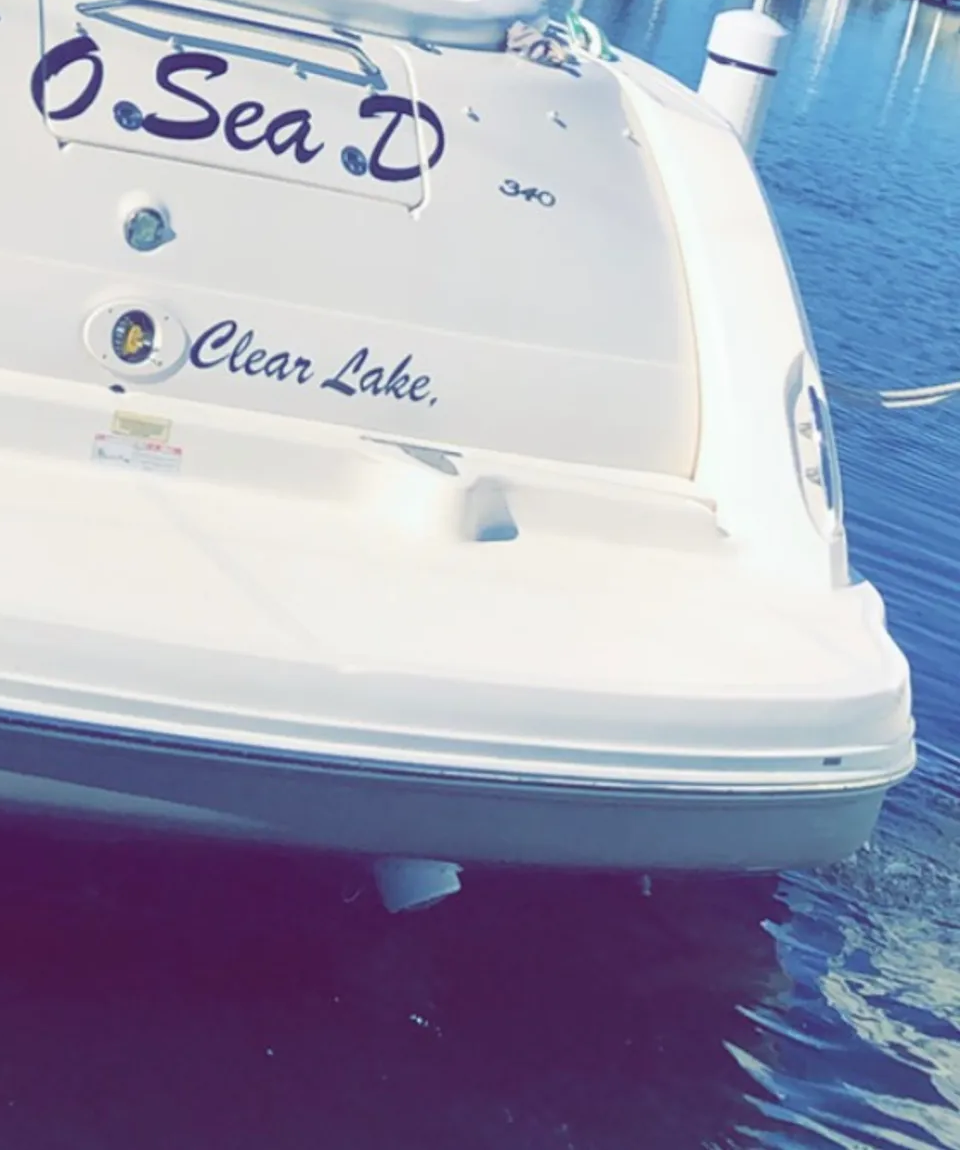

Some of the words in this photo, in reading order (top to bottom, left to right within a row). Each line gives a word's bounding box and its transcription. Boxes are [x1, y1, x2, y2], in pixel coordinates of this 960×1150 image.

[30, 36, 104, 121] O
[142, 52, 325, 164] Sea
[358, 95, 446, 182] D
[498, 178, 557, 208] 340
[187, 319, 315, 385] Clear
